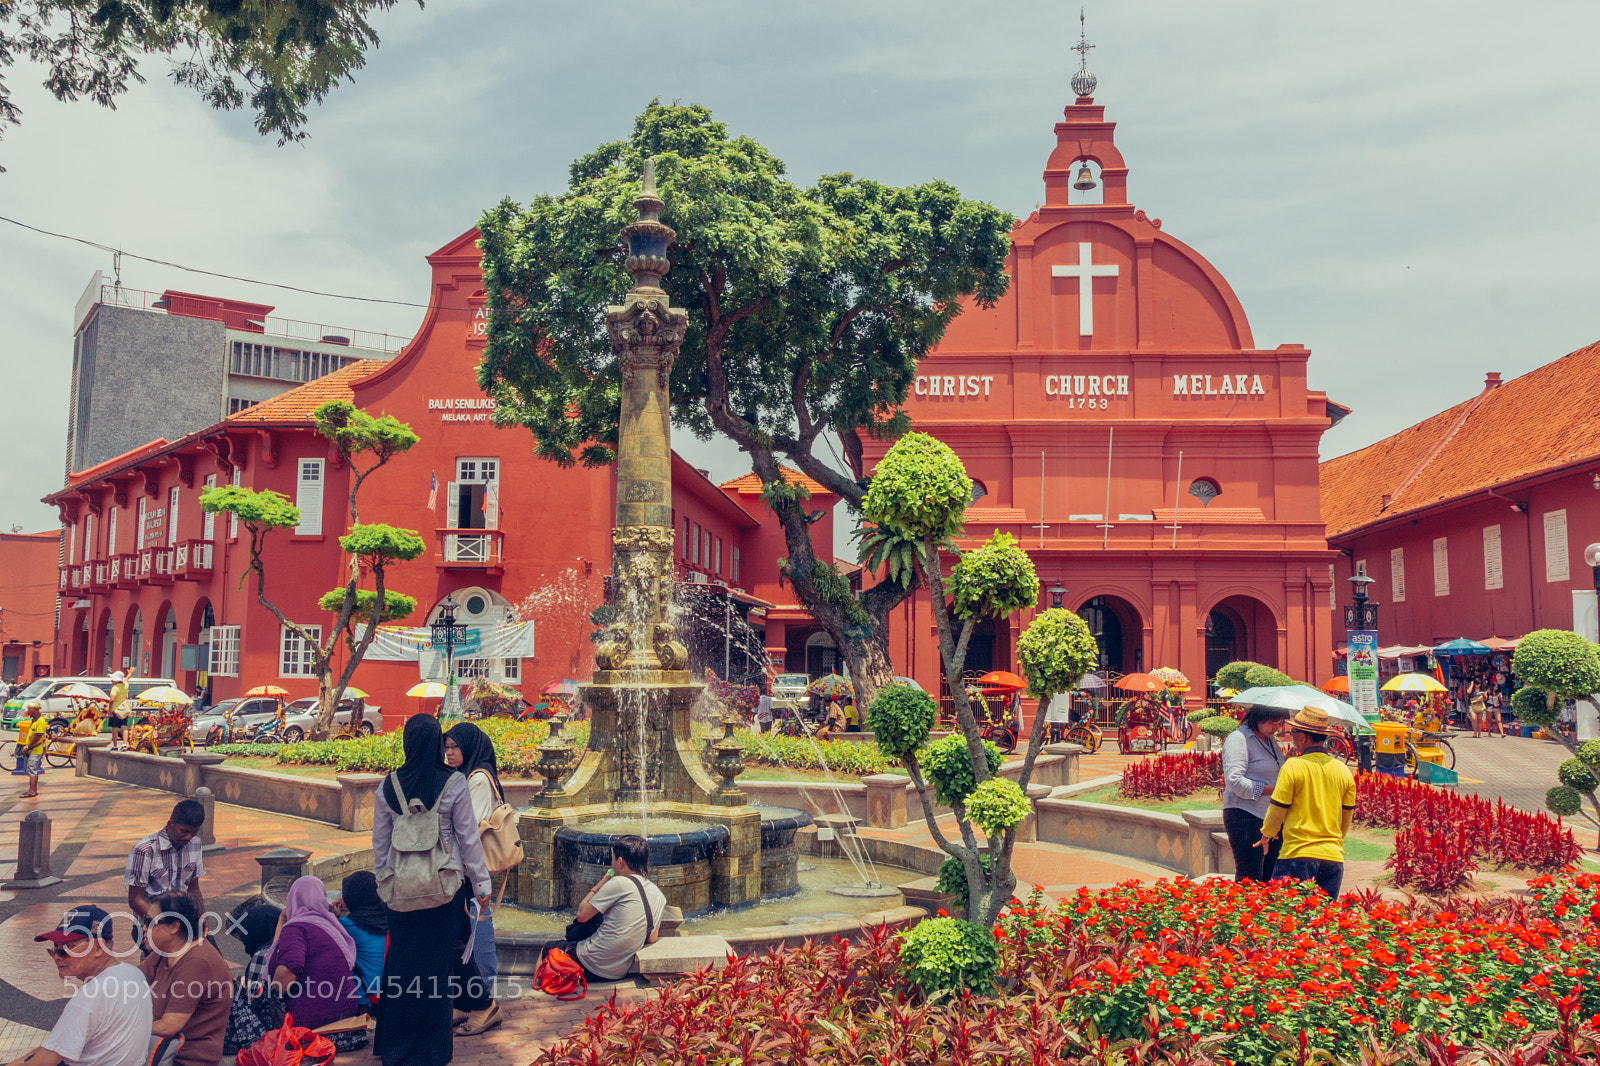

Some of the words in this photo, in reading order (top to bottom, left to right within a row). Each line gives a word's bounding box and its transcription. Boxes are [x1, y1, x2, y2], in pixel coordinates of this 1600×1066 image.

[473, 322, 488, 336] 19
[915, 376, 994, 396] CHRIST
[1045, 375, 1129, 396] CHURCH
[1173, 375, 1265, 395] MELAKA
[428, 399, 454, 409] BALAI
[1069, 398, 1109, 410] 1753
[442, 413, 471, 421] MELAKA
[473, 413, 488, 421] ART
[1352, 634, 1373, 643] astro
